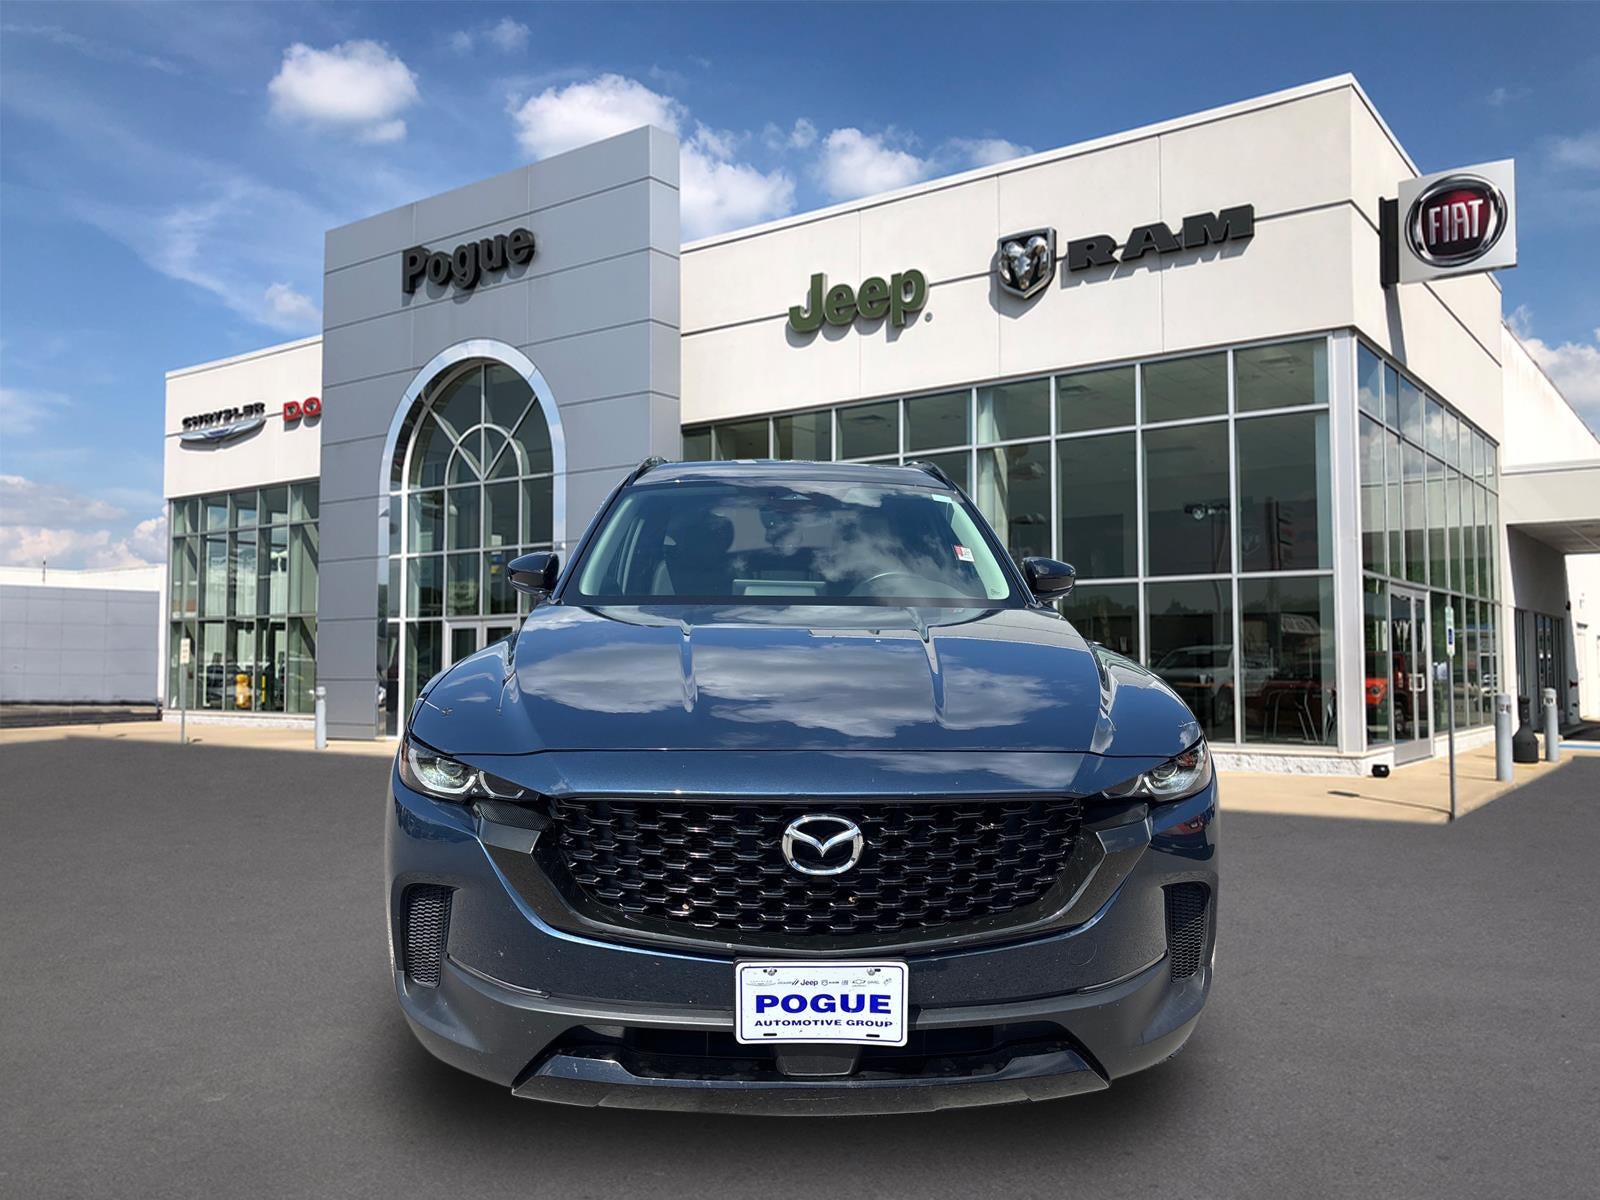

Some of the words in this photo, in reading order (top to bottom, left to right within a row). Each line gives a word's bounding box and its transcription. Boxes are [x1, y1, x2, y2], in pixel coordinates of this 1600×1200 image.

[1066, 203, 1255, 272] RAM
[1428, 198, 1484, 246] FIAT
[402, 227, 536, 294] Pogue
[788, 268, 928, 333] Jeep
[182, 402, 266, 429] CHRYSLER
[800, 979, 819, 987] Jeep
[755, 993, 892, 1015] POGUE
[754, 1018, 842, 1028] AUTOMOTIVE
[845, 1018, 894, 1028] GROUP
